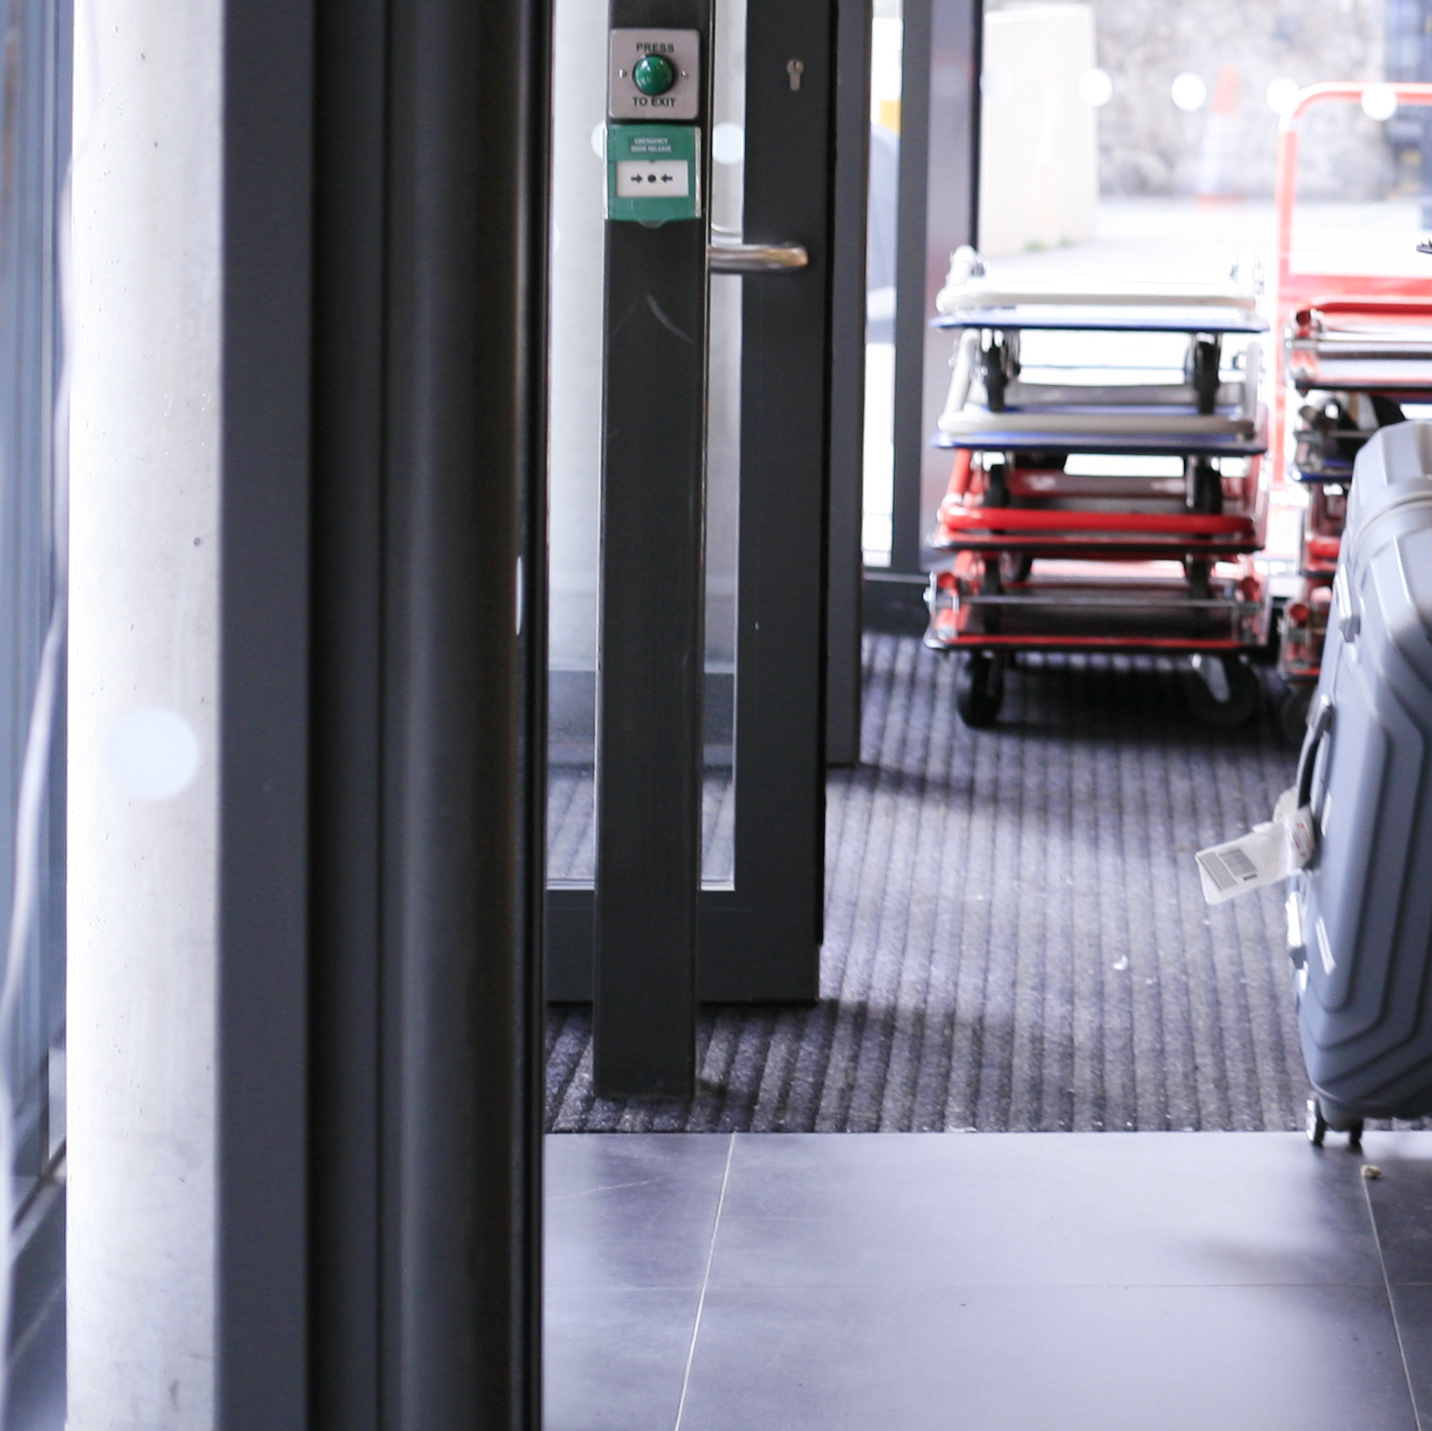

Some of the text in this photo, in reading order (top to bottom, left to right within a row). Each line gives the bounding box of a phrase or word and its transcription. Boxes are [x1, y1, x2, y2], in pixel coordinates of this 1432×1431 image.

[636, 42, 675, 54] PRESS
[632, 96, 677, 108] TO EXIT
